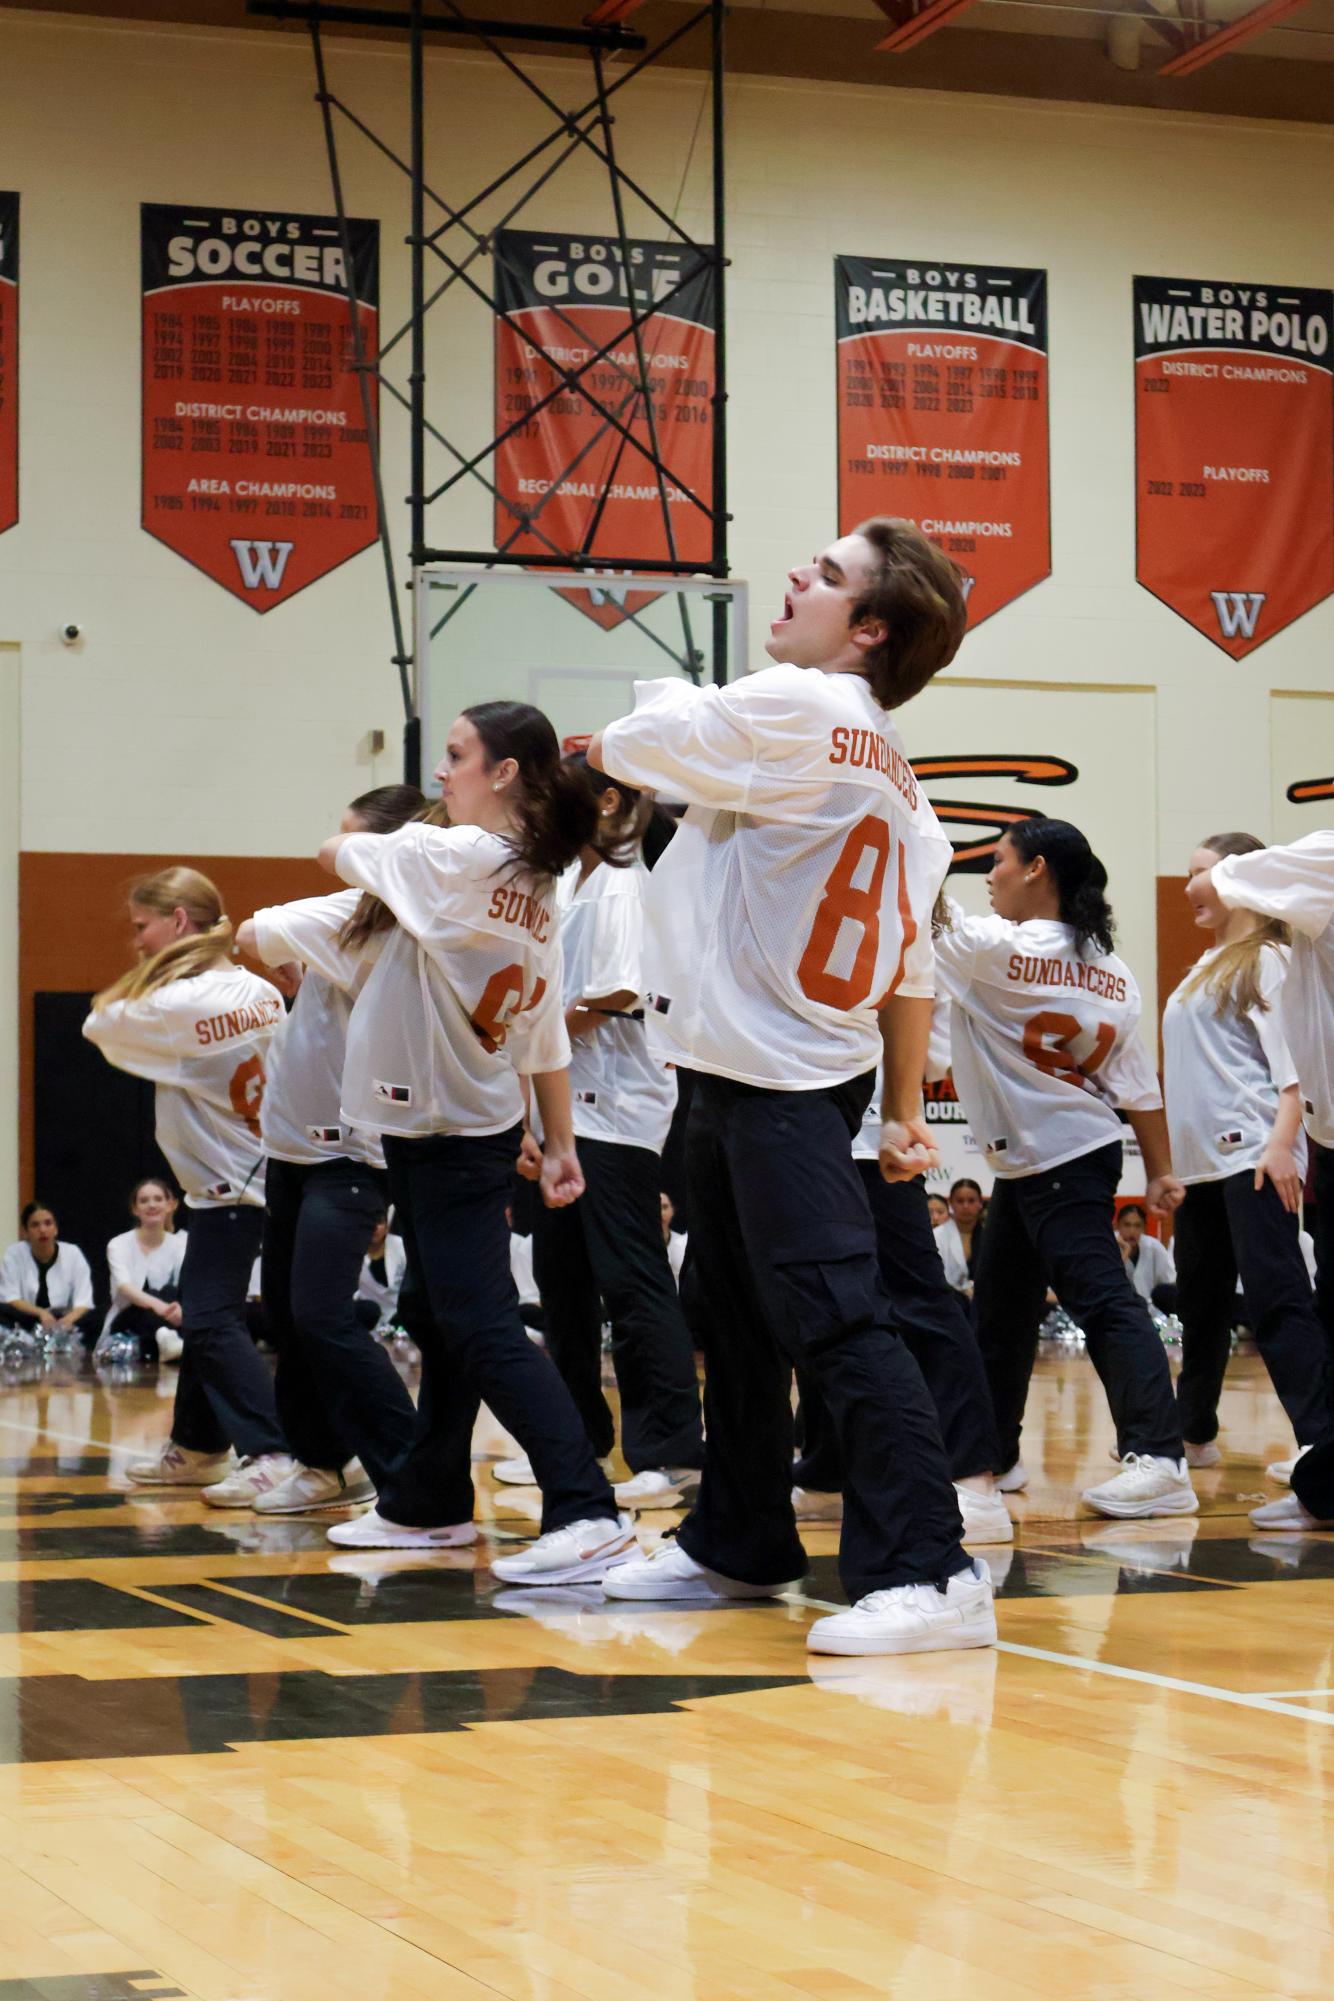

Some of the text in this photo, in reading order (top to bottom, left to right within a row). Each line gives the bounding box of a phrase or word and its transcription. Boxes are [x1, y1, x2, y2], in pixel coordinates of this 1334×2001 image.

[221, 217, 300, 239] BOYS
[167, 235, 352, 288] SOCCER
[569, 243, 644, 264] BOYS
[533, 260, 681, 303] GOLF
[906, 269, 978, 288] BOYS
[222, 296, 300, 315] PLAYOFFS
[1200, 287, 1268, 308] BOYS
[849, 286, 1035, 335] BASKETBALL
[1140, 302, 1328, 356] WATER POLO
[907, 343, 978, 361] PLAYOFFS
[1162, 361, 1308, 384] DISTRICT CHAMPIONS
[175, 402, 347, 425] DISTRICT CHAMPIONS
[866, 444, 1021, 466] DISTRICT CHAMPIONS
[1203, 465, 1270, 483] PLAYOFFS
[187, 478, 337, 499] AREA CHAMPIONS
[921, 519, 1013, 537] CHAMPIONS
[229, 539, 294, 589] W
[1210, 591, 1266, 638] W
[829, 727, 917, 811] SUNDANCERS
[1007, 954, 1127, 1002] SUNDANCERS
